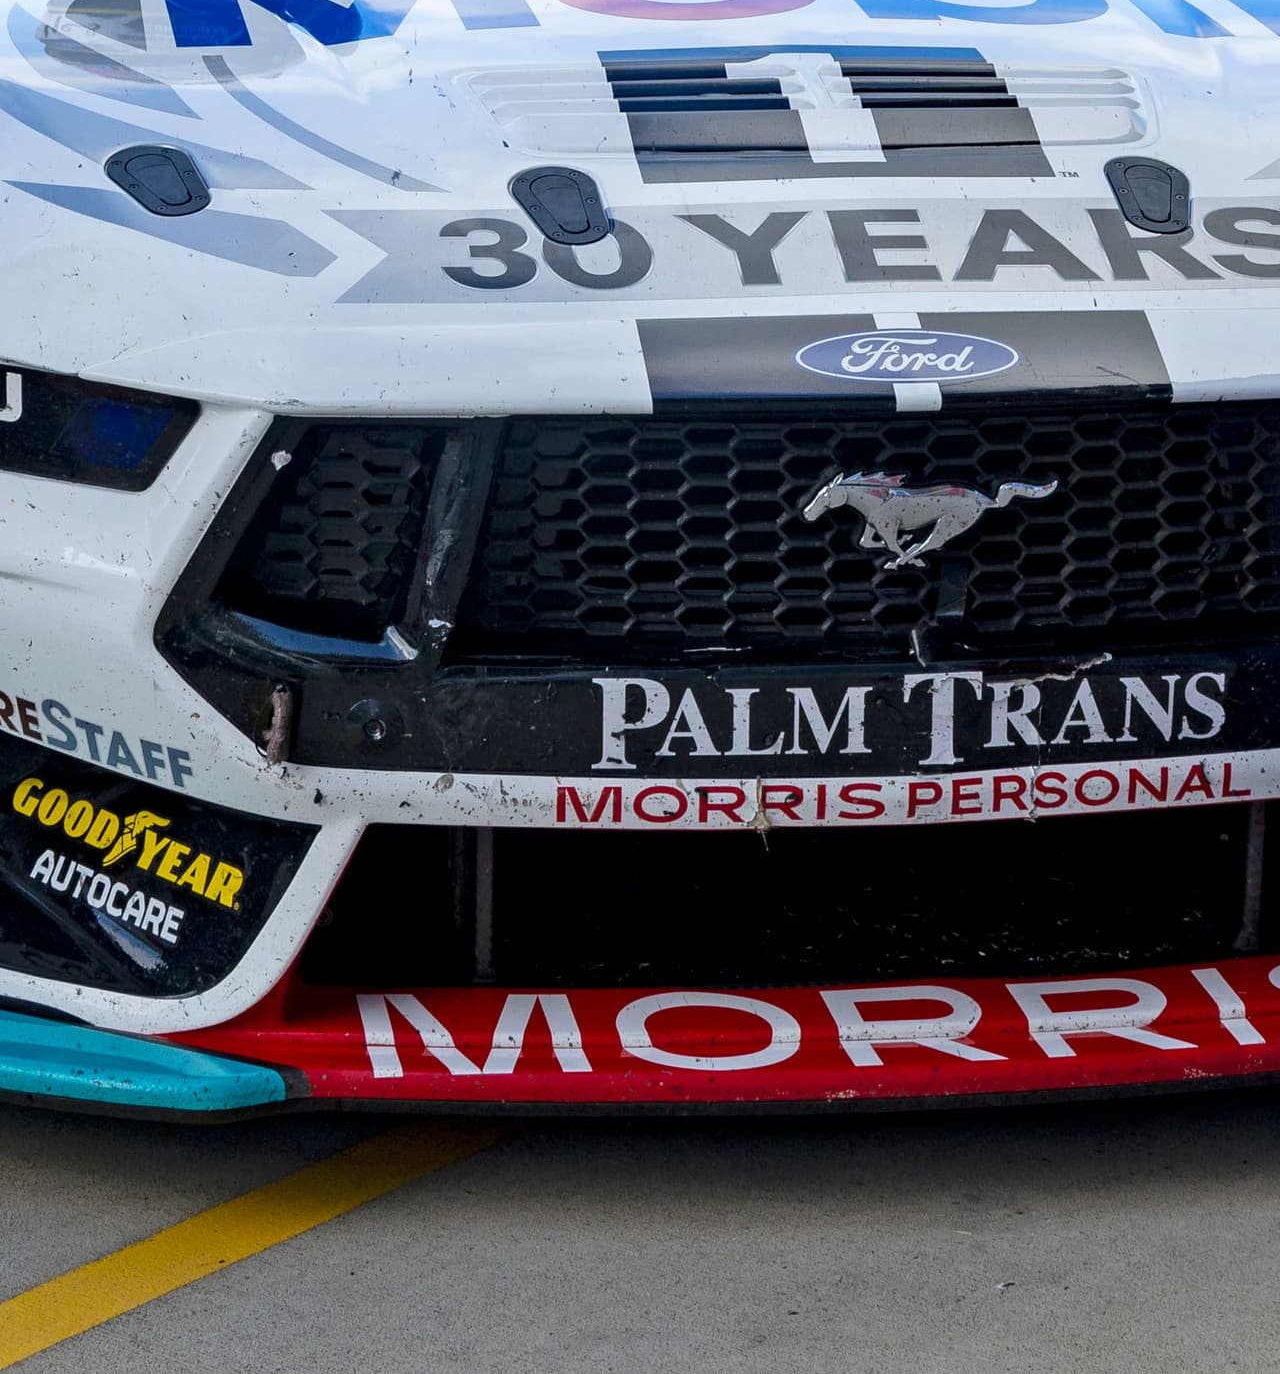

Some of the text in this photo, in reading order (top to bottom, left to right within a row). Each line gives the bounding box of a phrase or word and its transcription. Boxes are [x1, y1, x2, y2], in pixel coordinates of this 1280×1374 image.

[437, 216, 655, 291] 30
[839, 335, 976, 376] Ford
[590, 669, 1229, 772] PALM TRANS
[555, 761, 1254, 825] MORRIS PERSONAL
[29, 847, 187, 945] AUTOCARE
